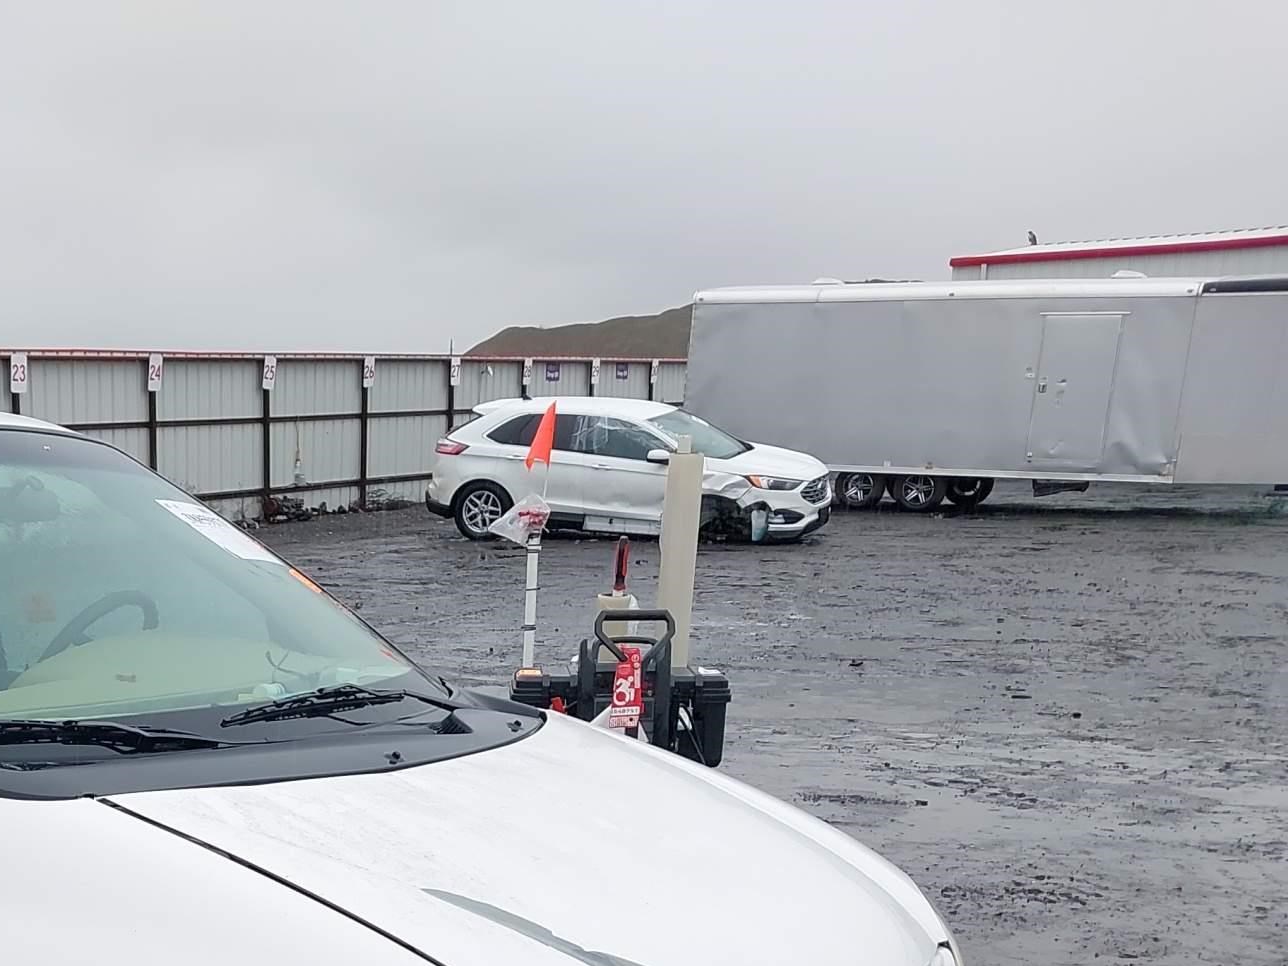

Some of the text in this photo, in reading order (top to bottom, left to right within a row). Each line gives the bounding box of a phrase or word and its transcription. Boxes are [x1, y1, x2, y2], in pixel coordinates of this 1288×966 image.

[12, 364, 26, 382] 23
[150, 365, 161, 381] 24
[264, 365, 275, 380] 25
[364, 365, 374, 379] 26
[451, 364, 460, 378] 27
